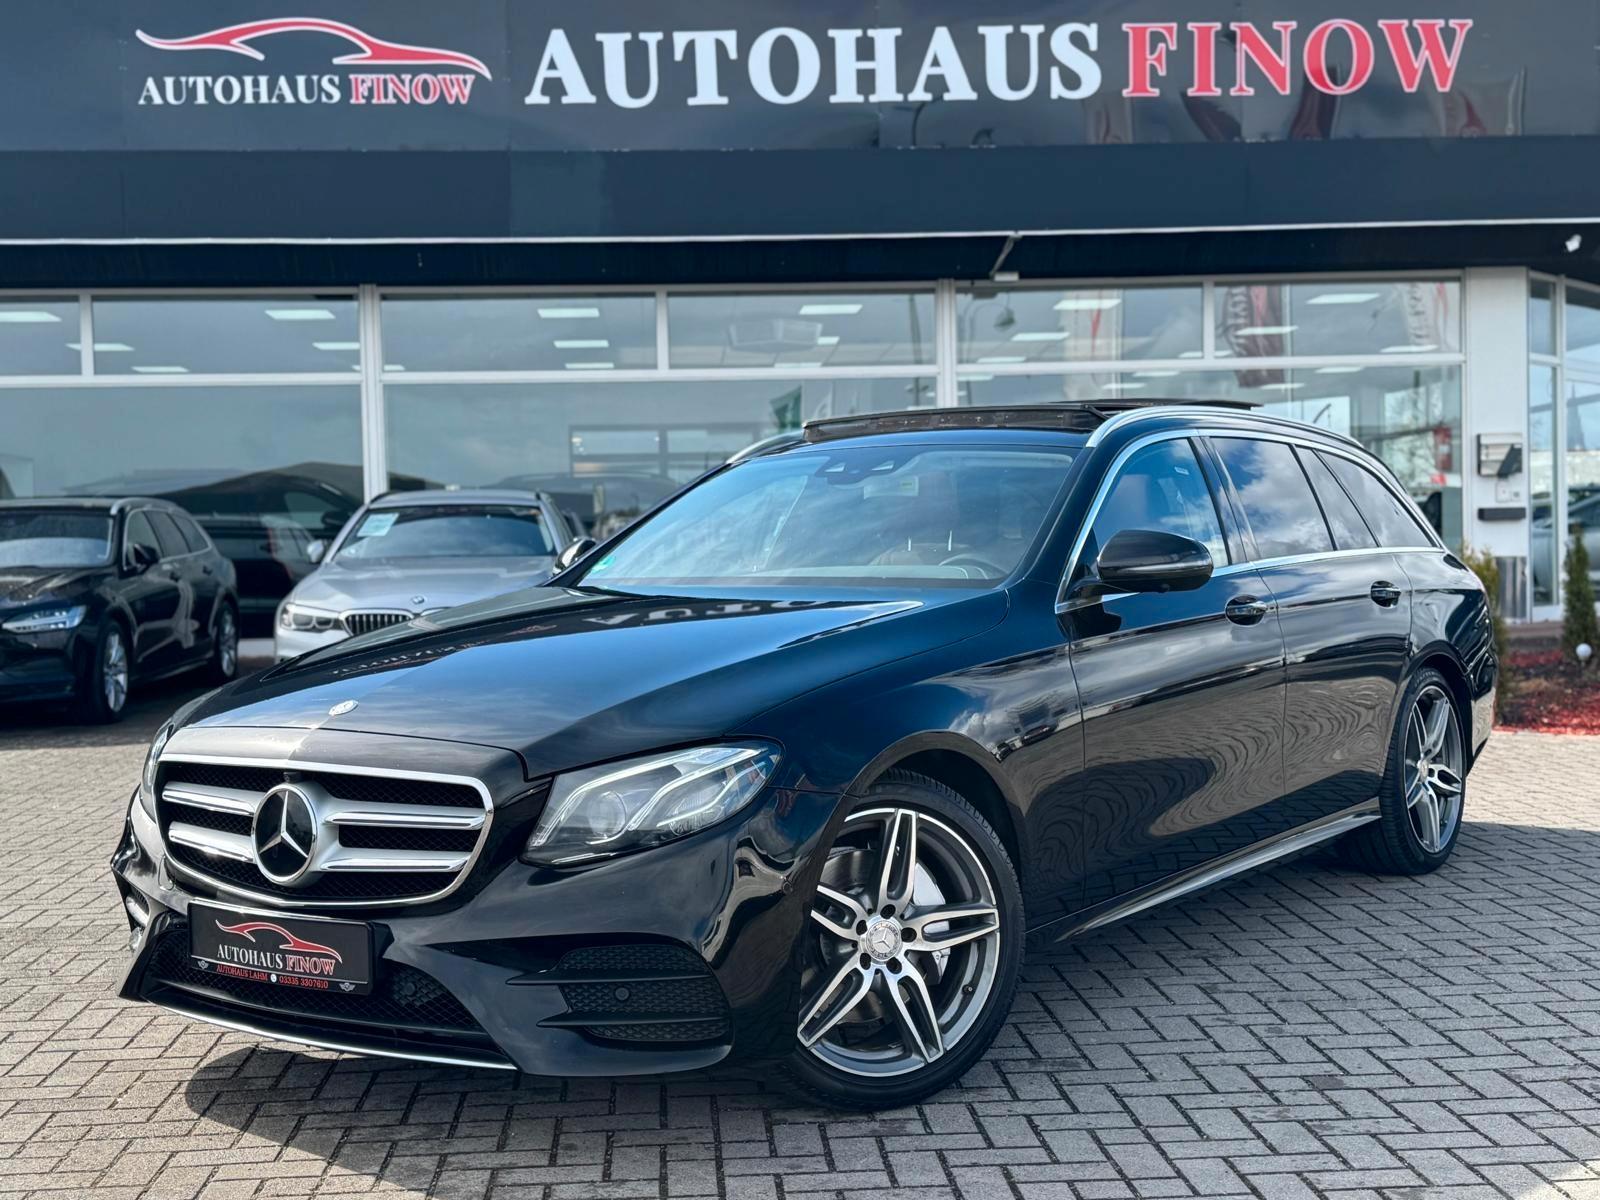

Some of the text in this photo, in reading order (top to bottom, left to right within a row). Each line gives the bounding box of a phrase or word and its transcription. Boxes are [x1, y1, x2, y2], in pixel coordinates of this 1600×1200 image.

[524, 18, 1474, 109] AUTOHAUS FINOW
[138, 73, 475, 106] AUTOHAUS FINOW
[216, 964, 249, 978] AUTOHAUS
[249, 971, 268, 982] LAHM
[279, 976, 299, 986] 03335
[217, 943, 336, 976] AUTOHAUS FINOW
